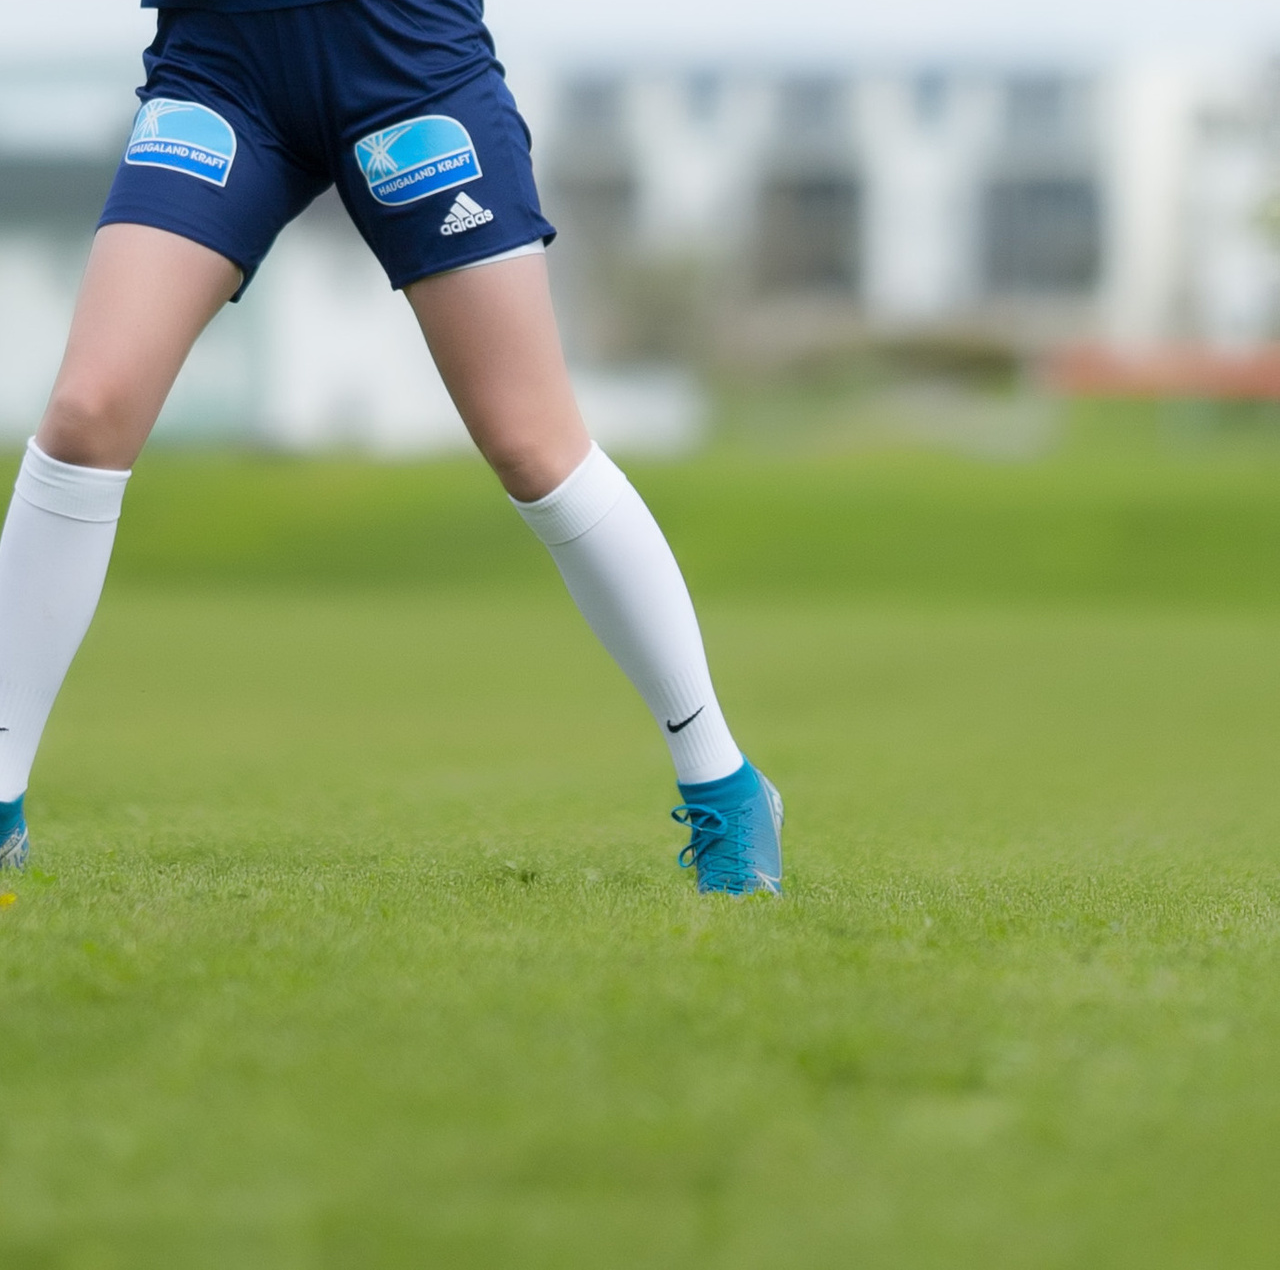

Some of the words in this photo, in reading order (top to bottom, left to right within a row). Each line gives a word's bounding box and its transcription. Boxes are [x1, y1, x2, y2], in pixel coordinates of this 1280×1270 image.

[129, 143, 189, 157] HAUGALAND
[190, 150, 225, 169] KRAFT
[378, 166, 436, 196] HAUGALAND
[437, 153, 471, 173] KRAFT
[440, 209, 494, 235] adidas
